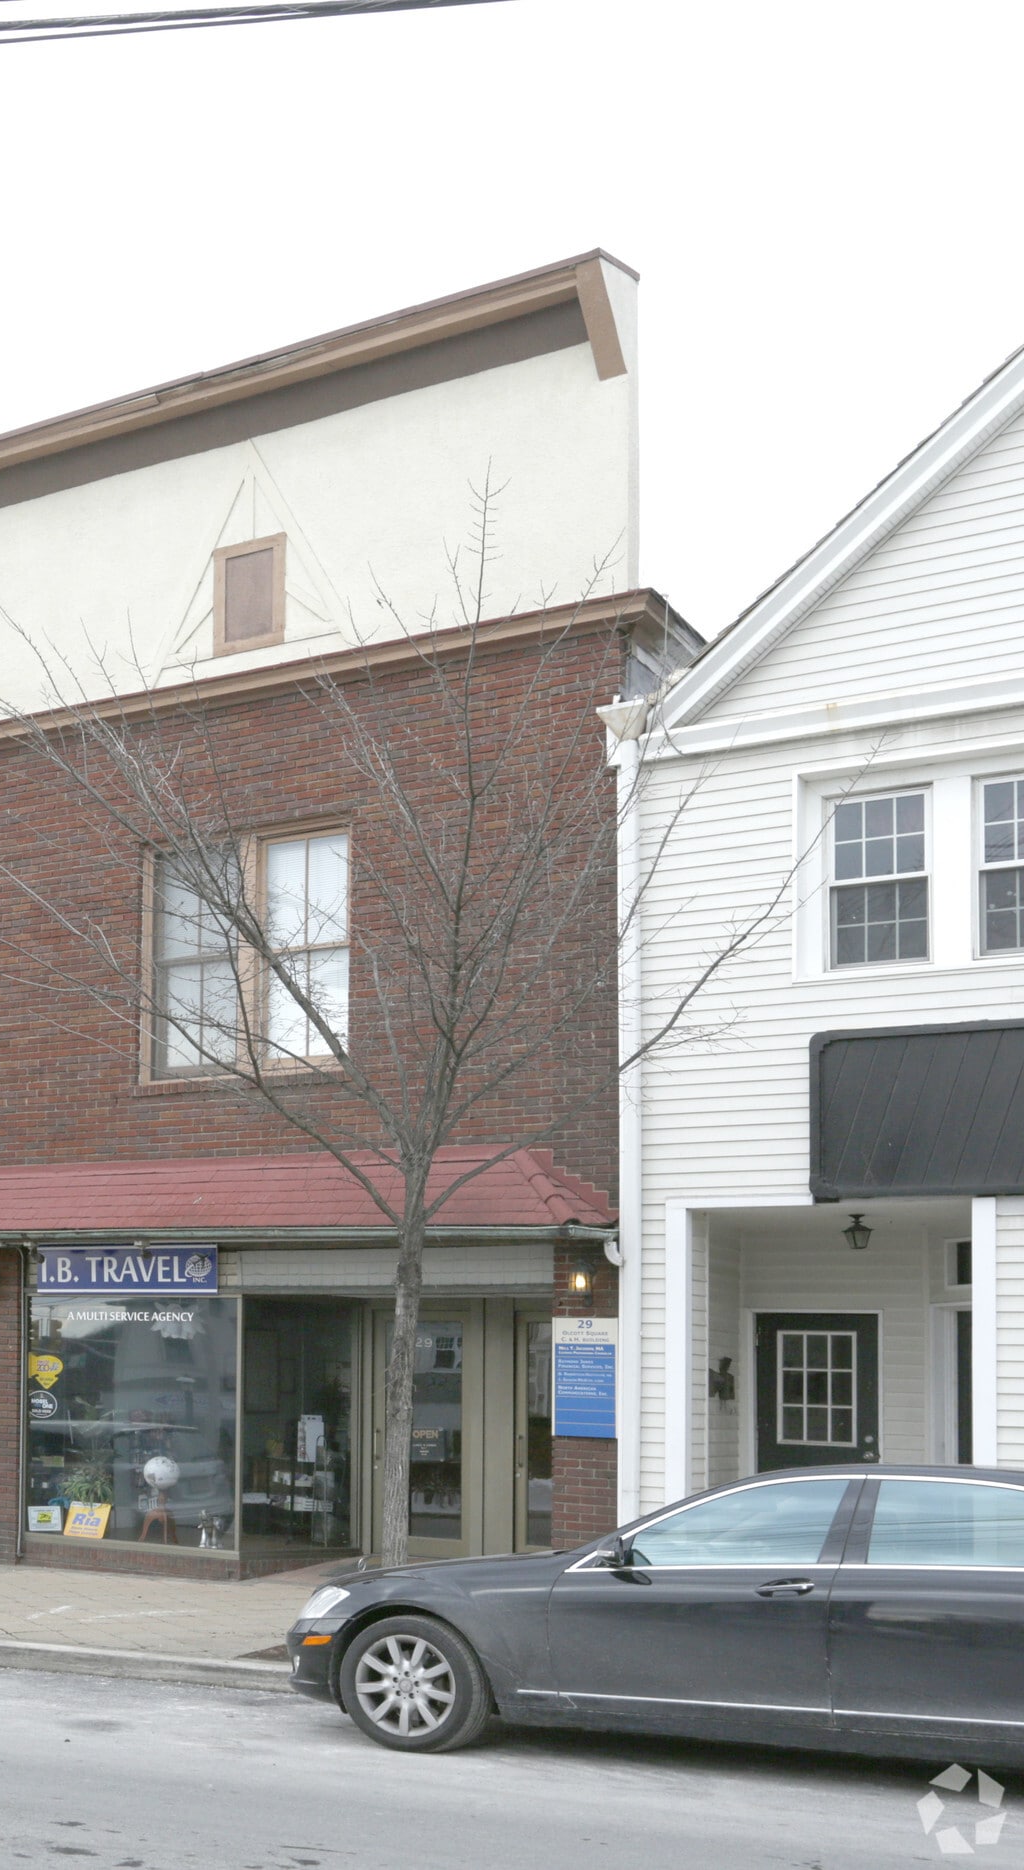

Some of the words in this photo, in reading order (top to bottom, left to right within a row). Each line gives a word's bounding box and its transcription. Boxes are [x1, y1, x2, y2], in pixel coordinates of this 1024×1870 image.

[41, 1257, 79, 1283] I.B.
[85, 1256, 186, 1283] TRAVEL
[67, 1312, 75, 1321] A
[76, 1312, 108, 1321] MULTI
[109, 1312, 149, 1322] SERVICE
[151, 1312, 194, 1322] AGENCY
[578, 1319, 593, 1329] 29
[415, 1337, 433, 1348] 29
[412, 1429, 439, 1439] OPEN
[72, 1511, 102, 1527] Ria
